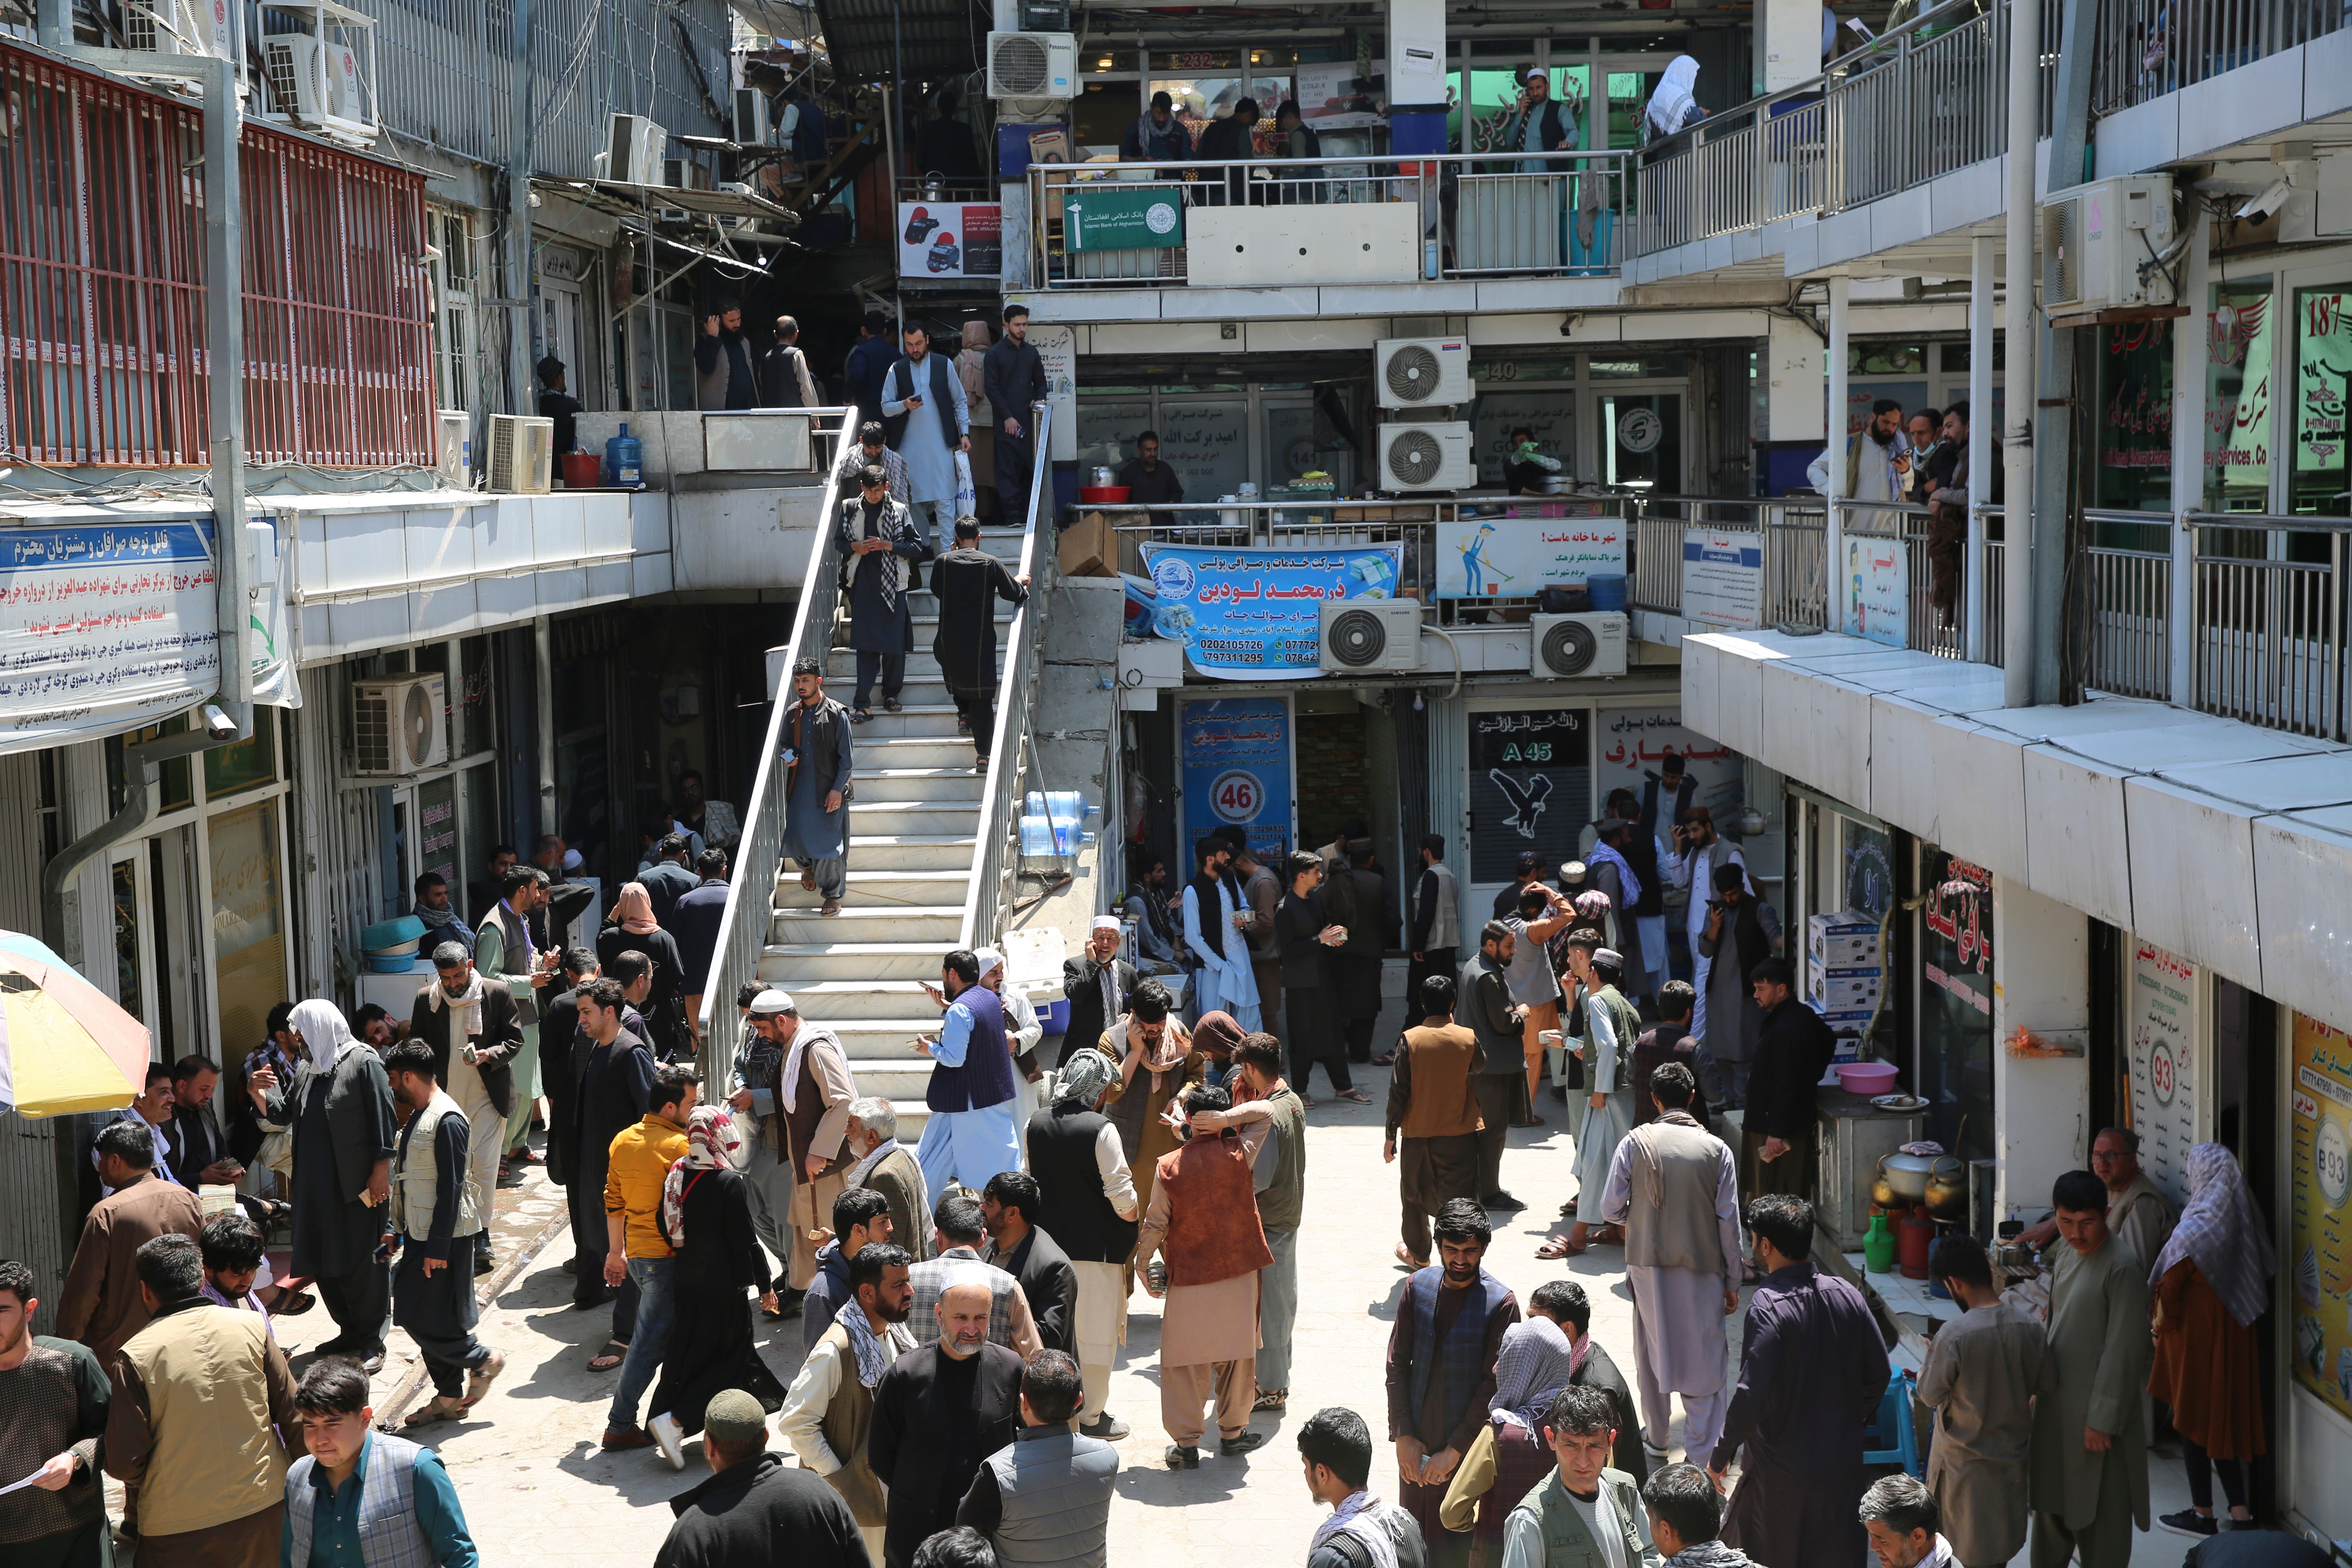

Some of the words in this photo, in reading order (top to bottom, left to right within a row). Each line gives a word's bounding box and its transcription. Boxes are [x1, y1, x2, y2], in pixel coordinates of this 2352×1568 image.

[216, 28, 225, 43] LG
[1183, 53, 1211, 68] 232
[347, 80, 354, 92] LG
[1085, 214, 1109, 222] افغانستان
[1111, 212, 1129, 220] اسلامی
[2089, 231, 2102, 241] CHIGO
[2309, 295, 2341, 336] 187
[1484, 362, 1516, 381] 140
[2237, 375, 2267, 433] شرکت
[1085, 412, 1112, 423] پولی
[1114, 409, 1147, 420] خدمات
[1169, 409, 1195, 421] صرافی
[1197, 409, 1223, 420] شرکت
[1552, 409, 1572, 418] شرکت
[1164, 429, 1181, 443] الله
[1185, 430, 1212, 446] برکت
[1215, 429, 1237, 445] امید
[1202, 452, 1220, 462] اجرای
[1292, 452, 1316, 464] 141
[2256, 445, 2266, 464] Co
[129, 531, 149, 556] توجه
[151, 529, 168, 555] قابل
[1548, 532, 1570, 542] ماست
[1572, 531, 1589, 542] خانه
[1592, 532, 1599, 541] ما
[1601, 532, 1616, 545] شهر
[14, 538, 44, 563] محترم
[47, 533, 85, 561] مشتریان
[88, 541, 94, 559] و
[96, 530, 126, 559] صرافان
[1198, 556, 1226, 572] پولی
[1228, 557, 1263, 571] صرافی
[1272, 557, 1309, 569] خدمات
[1312, 556, 1345, 570] شرکت
[1555, 553, 1574, 563] فرهنگ
[1576, 553, 1597, 563] نمایانگر
[1598, 553, 1610, 563] پاک
[1611, 554, 1621, 563] شهر
[1265, 561, 1271, 571] و
[1545, 568, 1559, 576] است
[1559, 568, 1570, 578] شهر
[1570, 569, 1585, 578] مردم
[129, 572, 150, 594] تجارتی
[152, 572, 165, 592] مرکز
[167, 571, 172, 591] از
[173, 570, 189, 590] خروج
[190, 572, 201, 589] عین
[202, 568, 215, 584] لطفا
[23, 580, 45, 603] دروازه
[48, 579, 53, 601] از
[56, 577, 87, 601] عبدالعزیز
[89, 575, 110, 597] شهزاده
[112, 575, 128, 595] سرای
[1198, 579, 1261, 604] لودین
[1265, 581, 1325, 599] محمد
[104, 608, 121, 630] مزاحم
[129, 606, 142, 626] کنید
[144, 604, 165, 621] استفاده
[1224, 610, 1249, 621] جات
[1251, 610, 1286, 621] حواله
[1289, 610, 1319, 622] جرای
[29, 615, 50, 637] نشوید
[52, 612, 74, 636] امنیتی
[76, 610, 102, 633] مسئولین
[1198, 625, 1218, 634] شریف
[1219, 626, 1234, 635] مزار
[1276, 626, 1294, 634] اسلام
[1200, 639, 1263, 650] 0202105726
[31, 648, 52, 663] استفاده
[1202, 652, 1263, 663] 0797311295
[1187, 713, 1205, 724] پولی
[1206, 713, 1231, 722] خدمات
[1231, 715, 1236, 723] و
[1236, 712, 1260, 722] صرافی
[1261, 710, 1283, 720] شرکت
[1530, 714, 1556, 731] خیر
[1556, 711, 1578, 730] والله
[1647, 714, 1682, 728] دمات
[1478, 715, 1530, 732] الرازقین
[1610, 715, 1644, 732] پولی
[1192, 728, 1230, 746] لودین
[1232, 729, 1268, 741] محمد
[1502, 742, 1522, 761] A
[1524, 742, 1552, 761] 45
[1605, 738, 1674, 769] عارف
[1220, 783, 1252, 809] 46
[1864, 868, 1879, 913] 91
[2155, 1055, 2170, 1091] 93
[2319, 1148, 2326, 1171] B
[2329, 1149, 2345, 1185] 93
